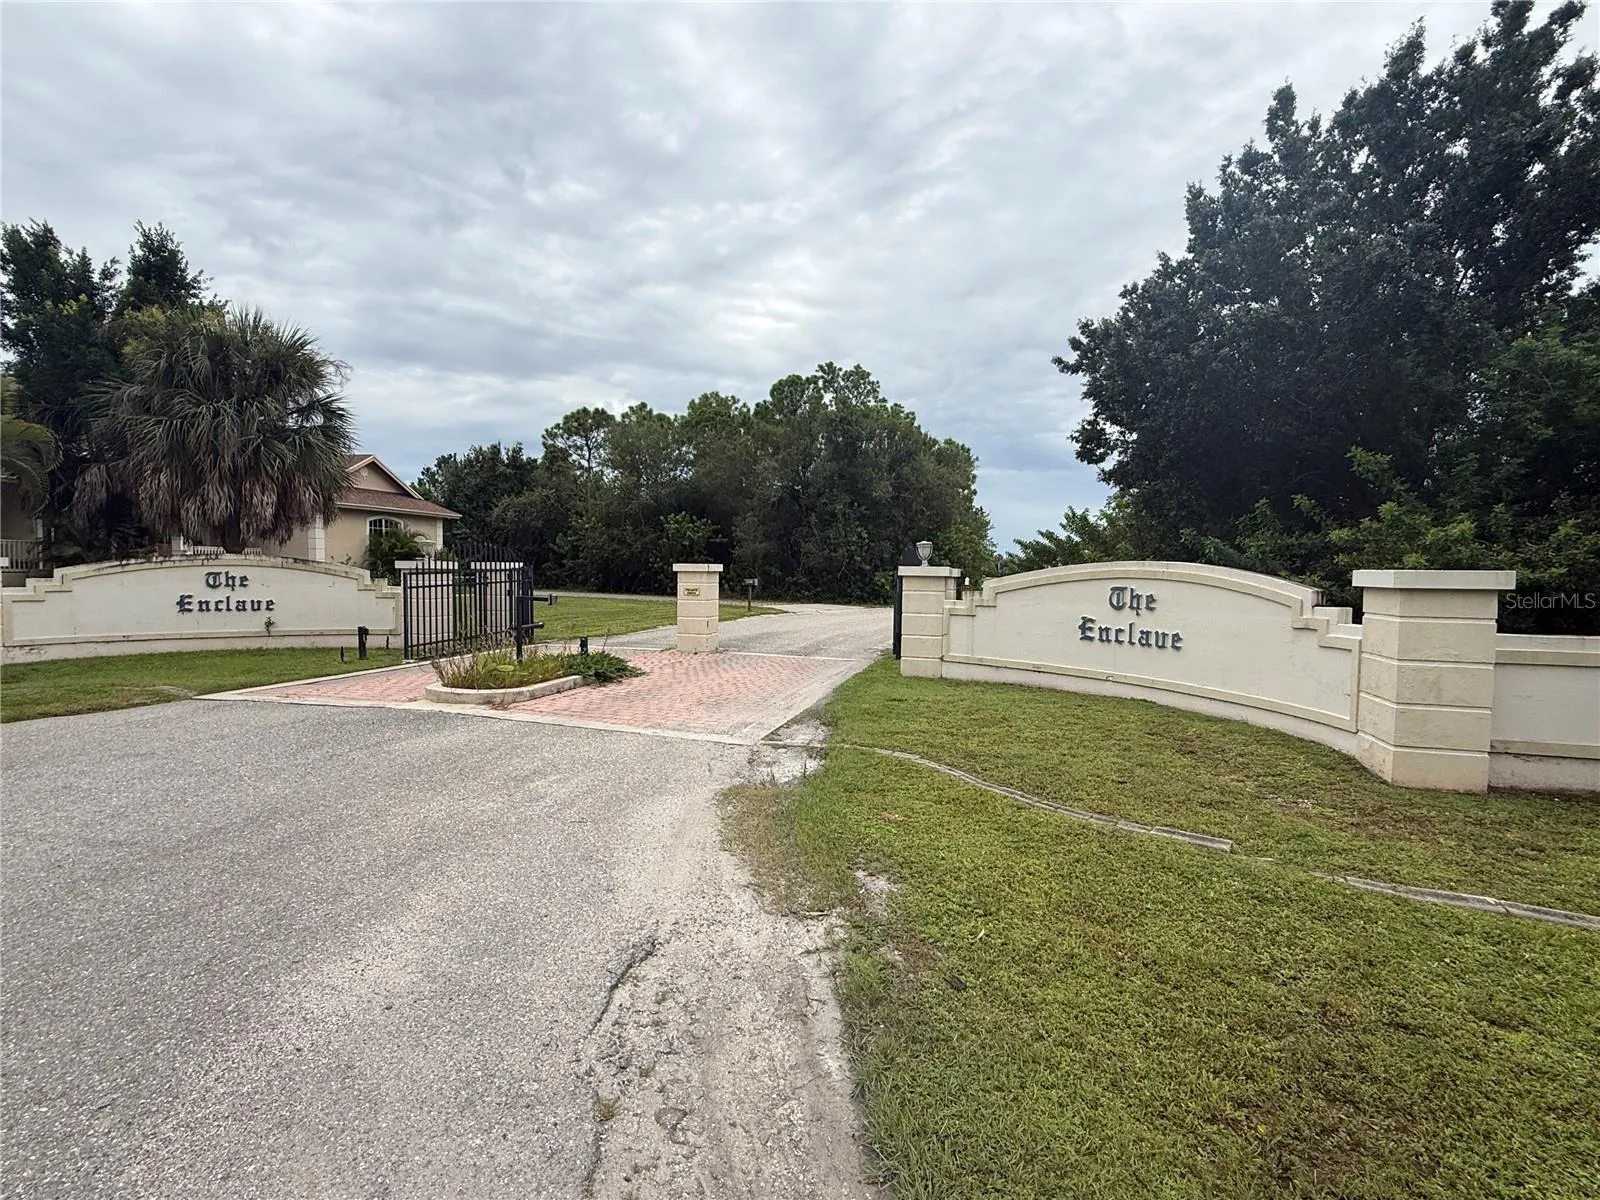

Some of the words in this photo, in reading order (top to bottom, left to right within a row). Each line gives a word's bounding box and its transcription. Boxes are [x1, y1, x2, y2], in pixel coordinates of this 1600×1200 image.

[205, 571, 249, 591] The
[176, 595, 275, 613] Enclave
[1109, 586, 1157, 616] The
[1078, 616, 1183, 650] Enclave
